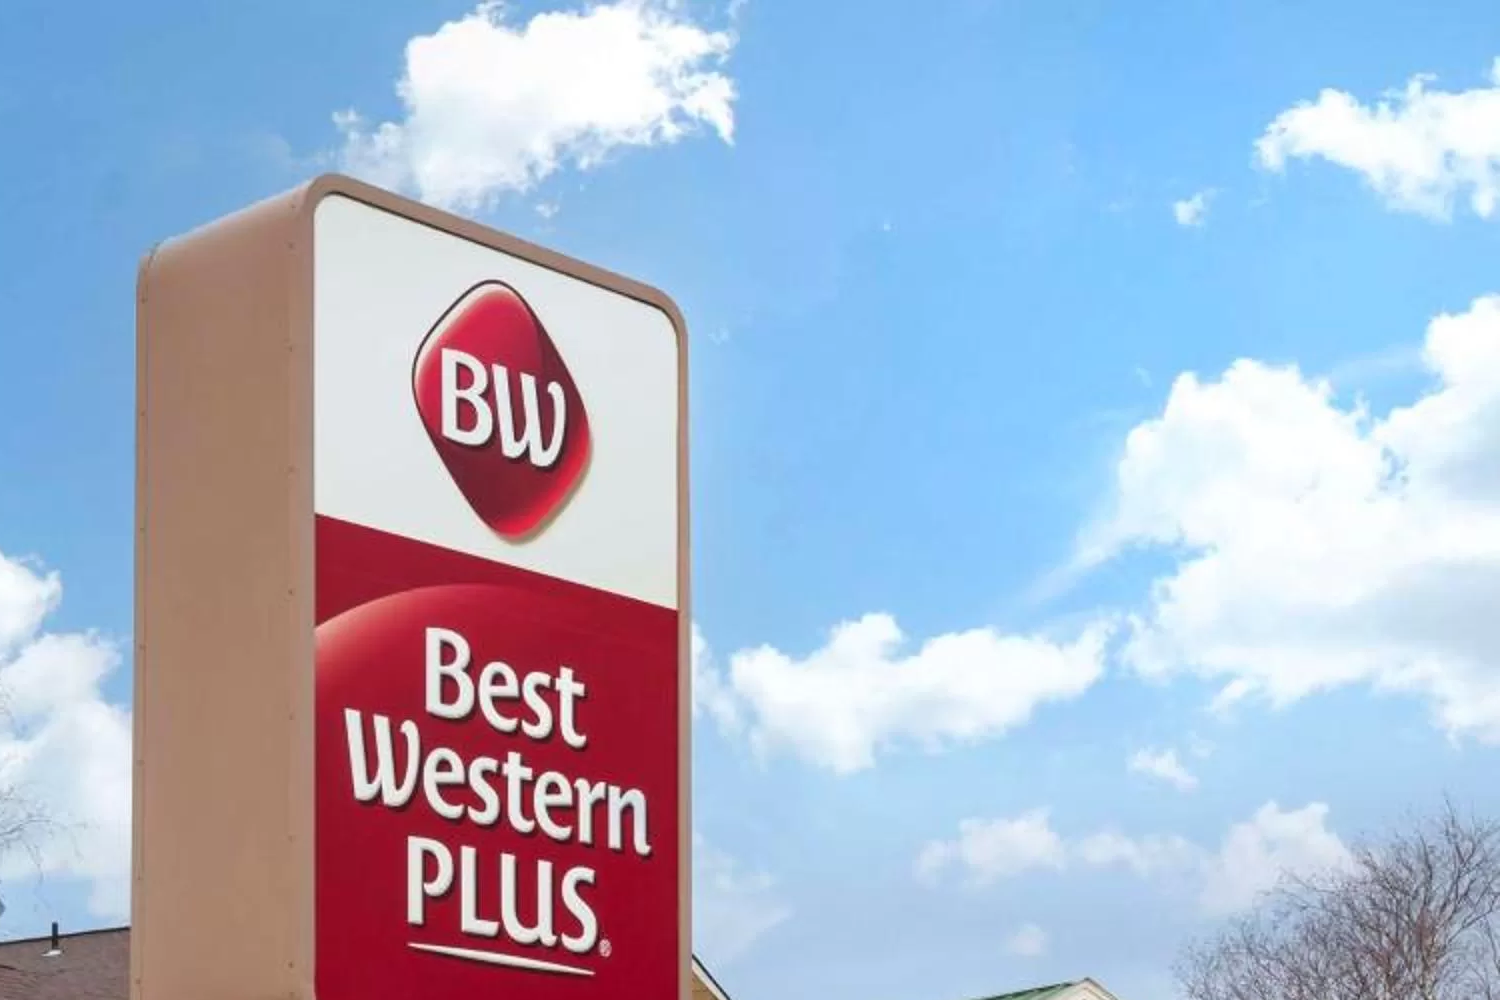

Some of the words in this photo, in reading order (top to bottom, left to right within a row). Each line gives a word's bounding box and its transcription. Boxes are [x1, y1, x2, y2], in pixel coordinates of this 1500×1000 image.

[441, 347, 566, 467] BW
[425, 626, 587, 748] Best
[344, 707, 652, 855] Western
